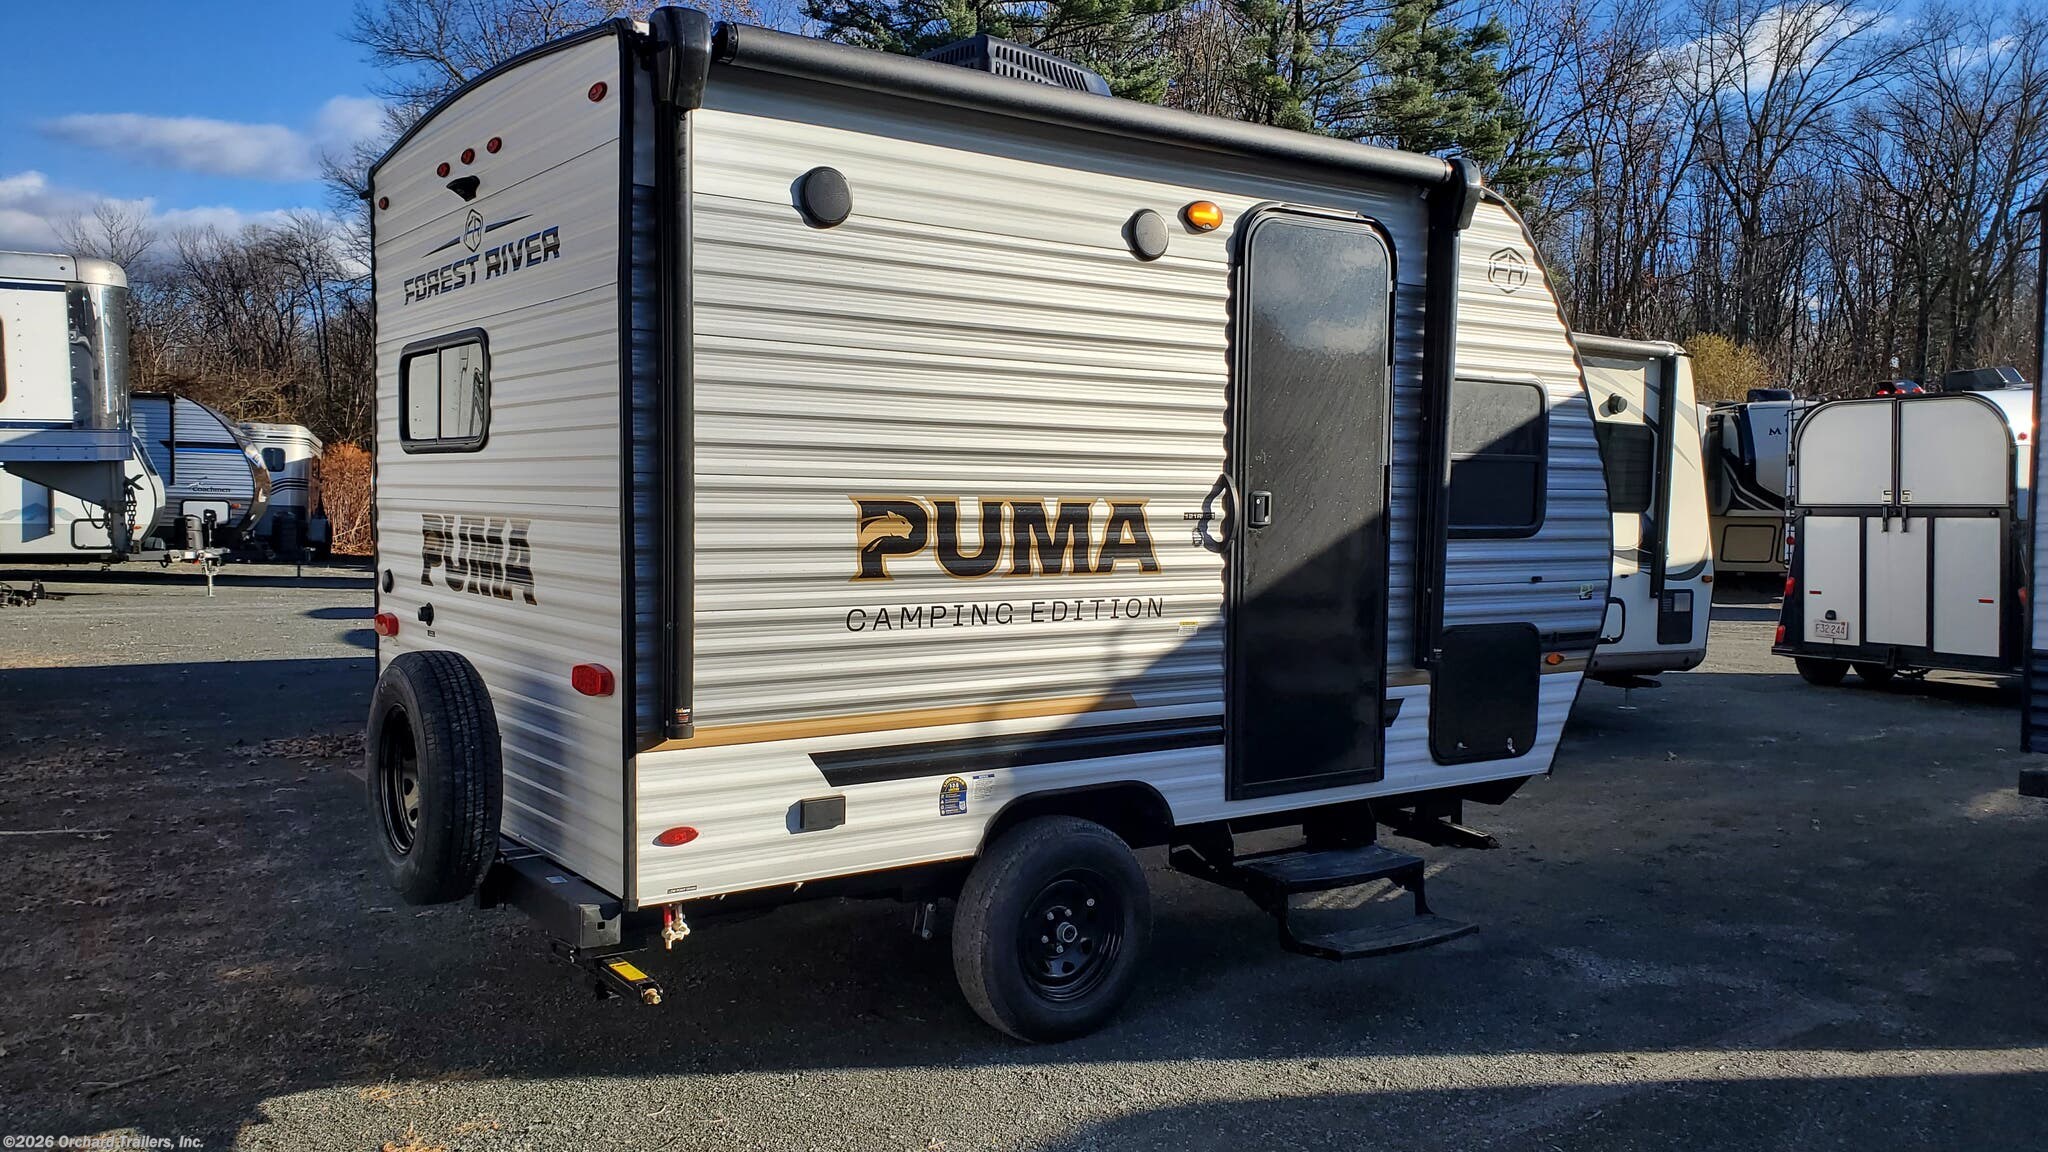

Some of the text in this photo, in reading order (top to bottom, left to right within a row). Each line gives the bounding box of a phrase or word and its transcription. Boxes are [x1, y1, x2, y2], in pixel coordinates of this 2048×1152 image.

[404, 226, 560, 305] FOREST RIVER
[421, 513, 537, 606] PUMA
[848, 496, 1162, 582] PUMA
[845, 597, 1164, 632] CAMPING EDITION
